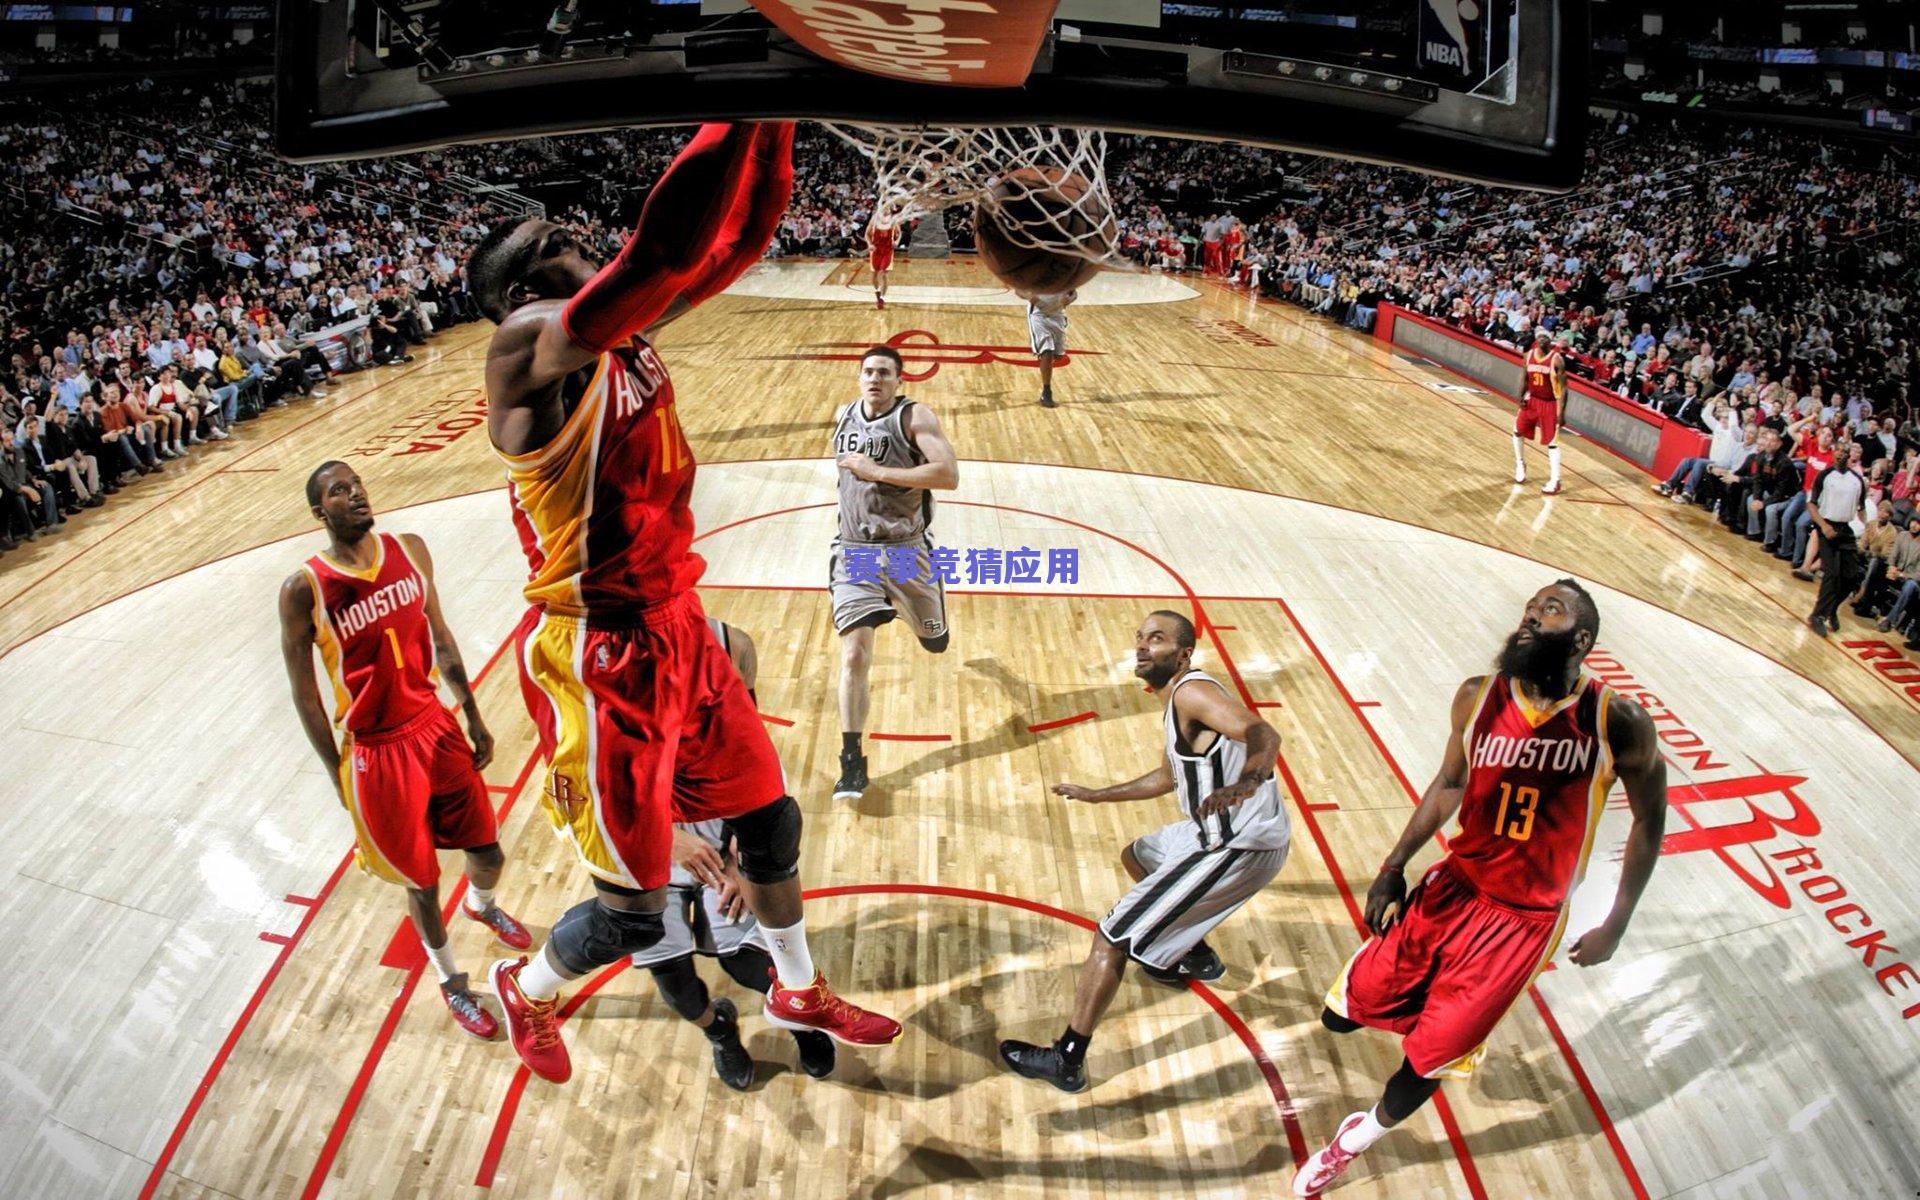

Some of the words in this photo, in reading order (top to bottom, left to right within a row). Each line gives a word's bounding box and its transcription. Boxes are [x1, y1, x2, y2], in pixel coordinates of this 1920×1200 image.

[1426, 41, 1460, 67] NBA
[1533, 372, 1544, 386] 31
[342, 389, 482, 458] CENTER
[838, 432, 859, 454] 16
[334, 572, 420, 641] HOUSTON
[384, 627, 404, 670] 1
[1584, 643, 1731, 771] OUSTON
[1472, 732, 1592, 774] HOUSTON
[1494, 781, 1540, 841] 13
